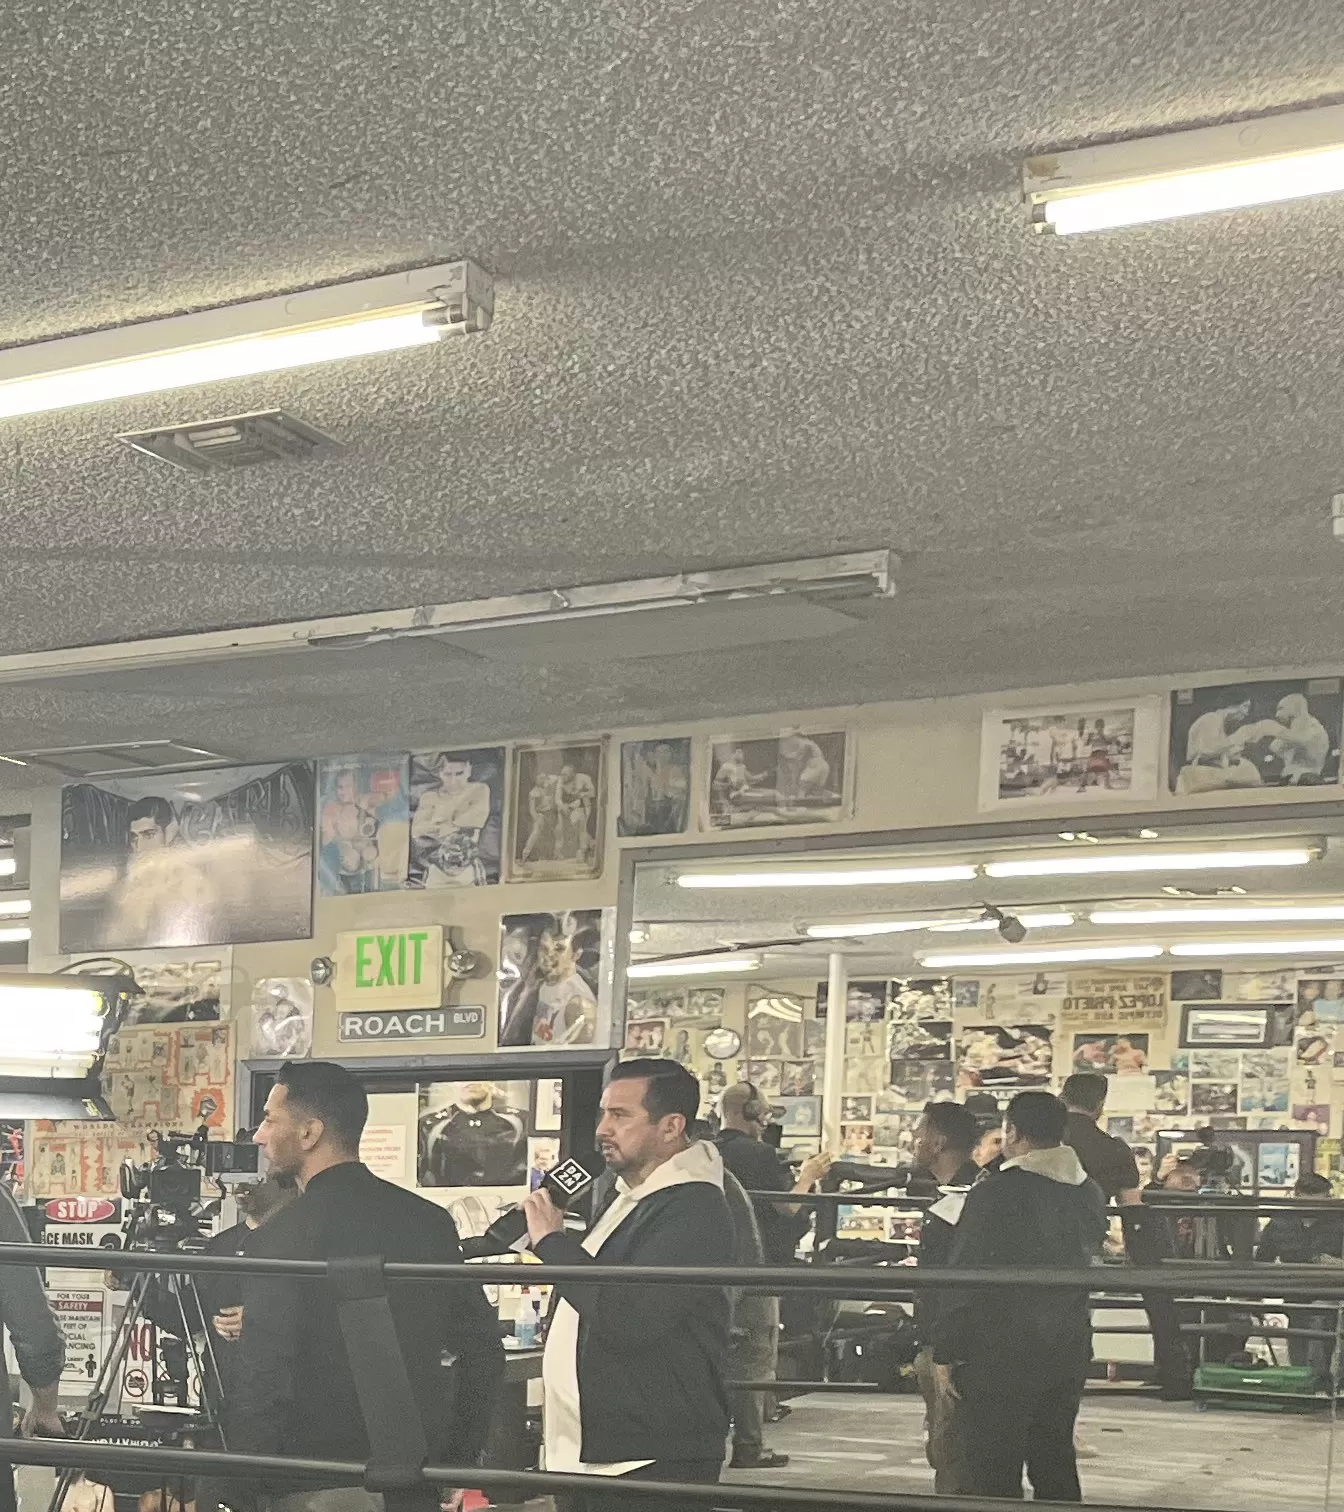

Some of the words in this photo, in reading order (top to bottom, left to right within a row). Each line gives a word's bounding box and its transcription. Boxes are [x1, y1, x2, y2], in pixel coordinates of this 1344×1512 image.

[356, 932, 429, 988] EXIT
[344, 1013, 445, 1036] ROACH
[453, 1012, 479, 1024] BLVD
[57, 1201, 98, 1219] STOP
[46, 1232, 61, 1246] CE
[62, 1232, 94, 1246] MASK
[58, 1301, 89, 1311] SAFETY
[123, 1322, 155, 1362] NO
